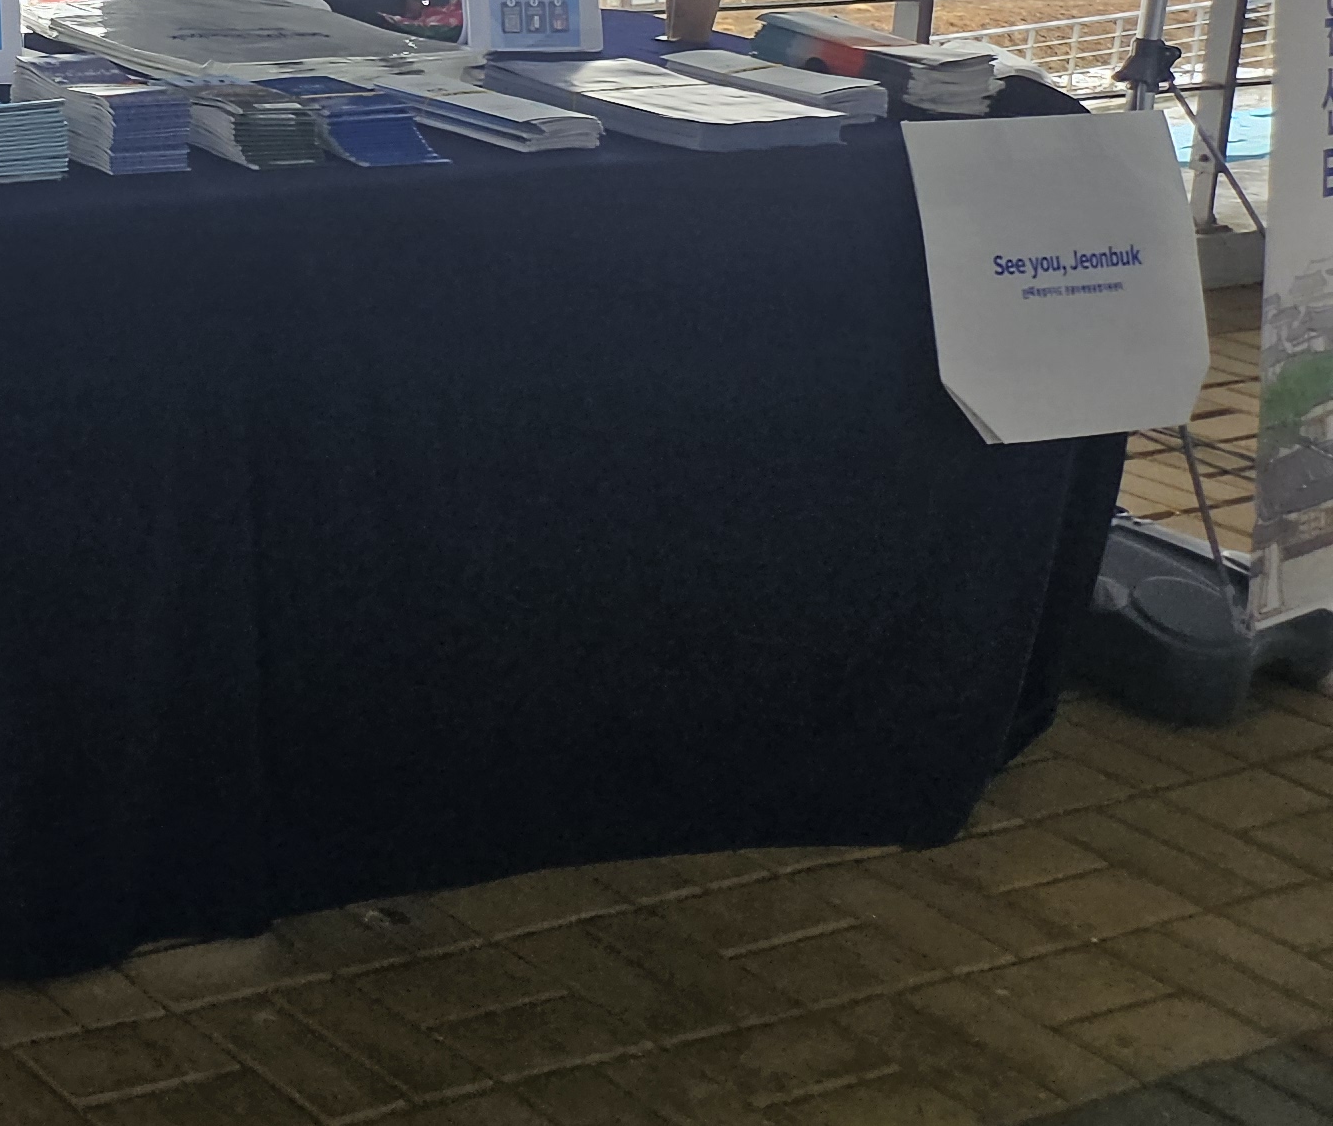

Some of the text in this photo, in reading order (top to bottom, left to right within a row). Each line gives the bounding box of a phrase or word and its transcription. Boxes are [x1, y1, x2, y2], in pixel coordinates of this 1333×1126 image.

[993, 244, 1143, 279] See you, Jeonbuk
